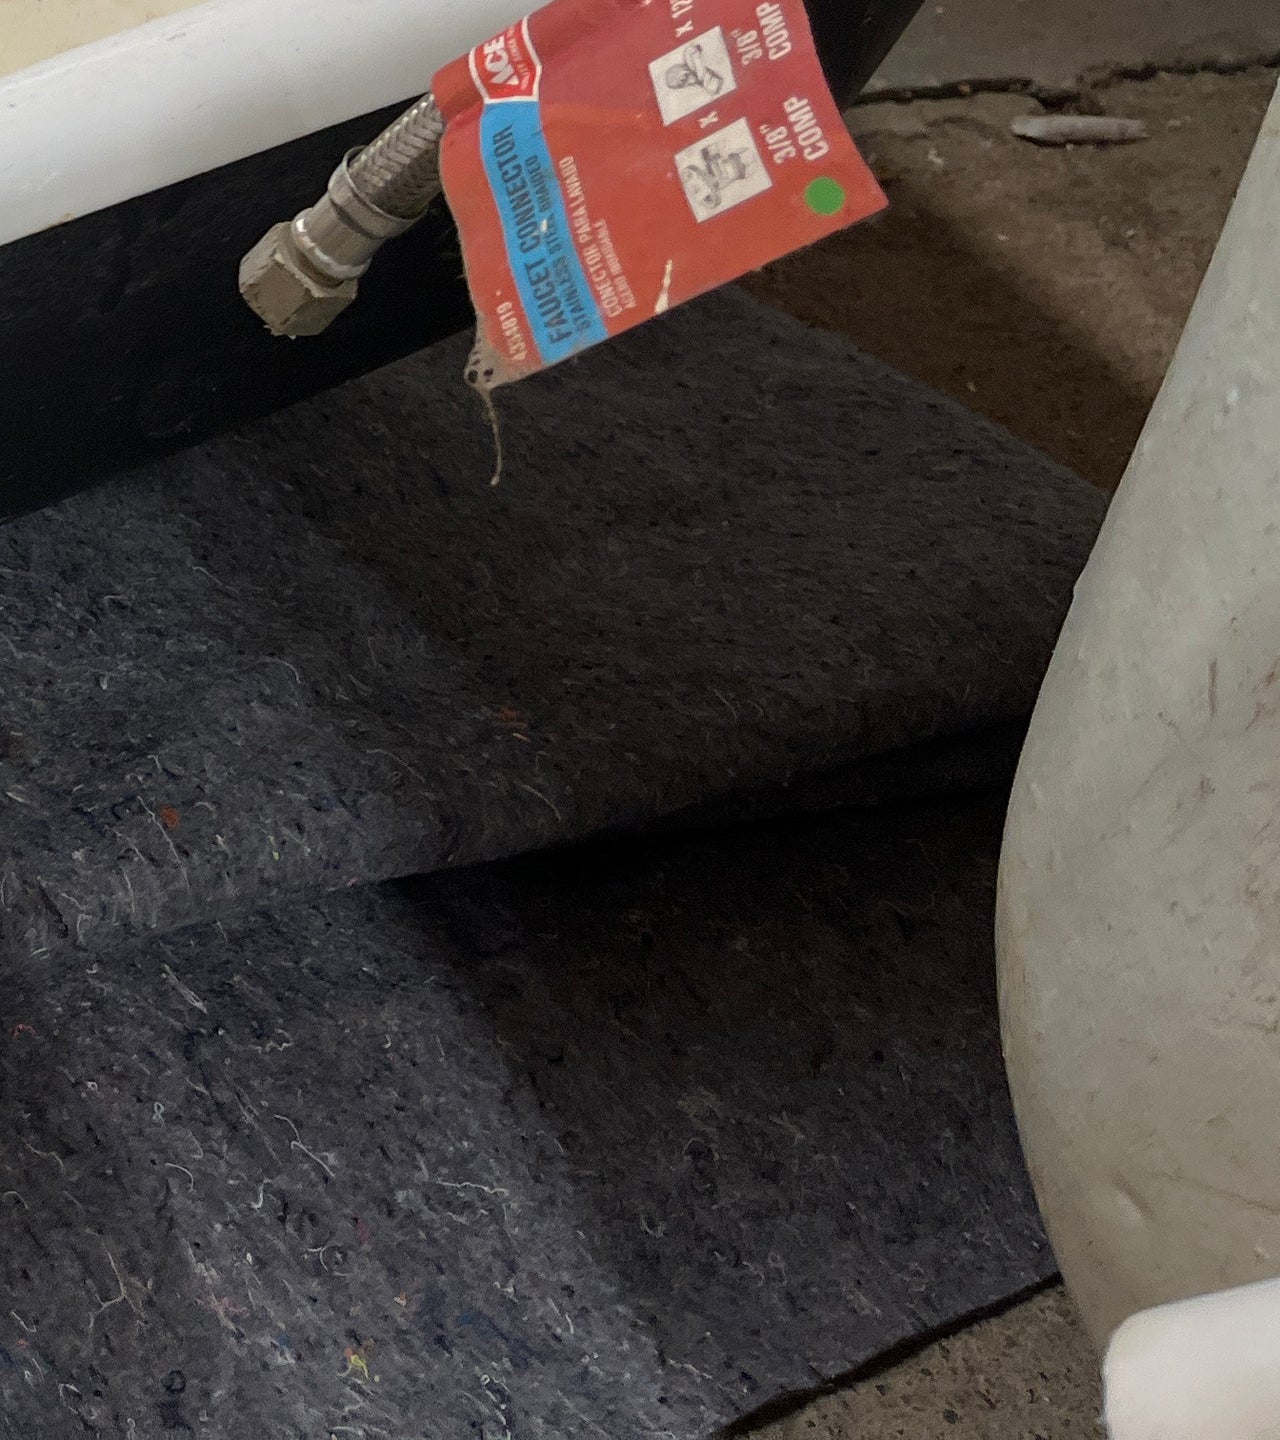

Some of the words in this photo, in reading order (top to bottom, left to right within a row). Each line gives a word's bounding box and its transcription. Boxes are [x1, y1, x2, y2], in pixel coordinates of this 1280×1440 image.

[730, 28, 763, 65] 3/8"
[755, 1, 791, 60] COMP
[483, 35, 520, 86] ACE
[759, 124, 796, 164] 3/8"
[783, 97, 829, 161] COMP
[492, 124, 541, 254] CONNECTOR
[524, 155, 552, 213] BRAIDED
[572, 206, 593, 244] PARA
[524, 258, 573, 344] FAUCET
[552, 256, 591, 331] STAINLESS
[583, 243, 623, 317] CONECTOR
